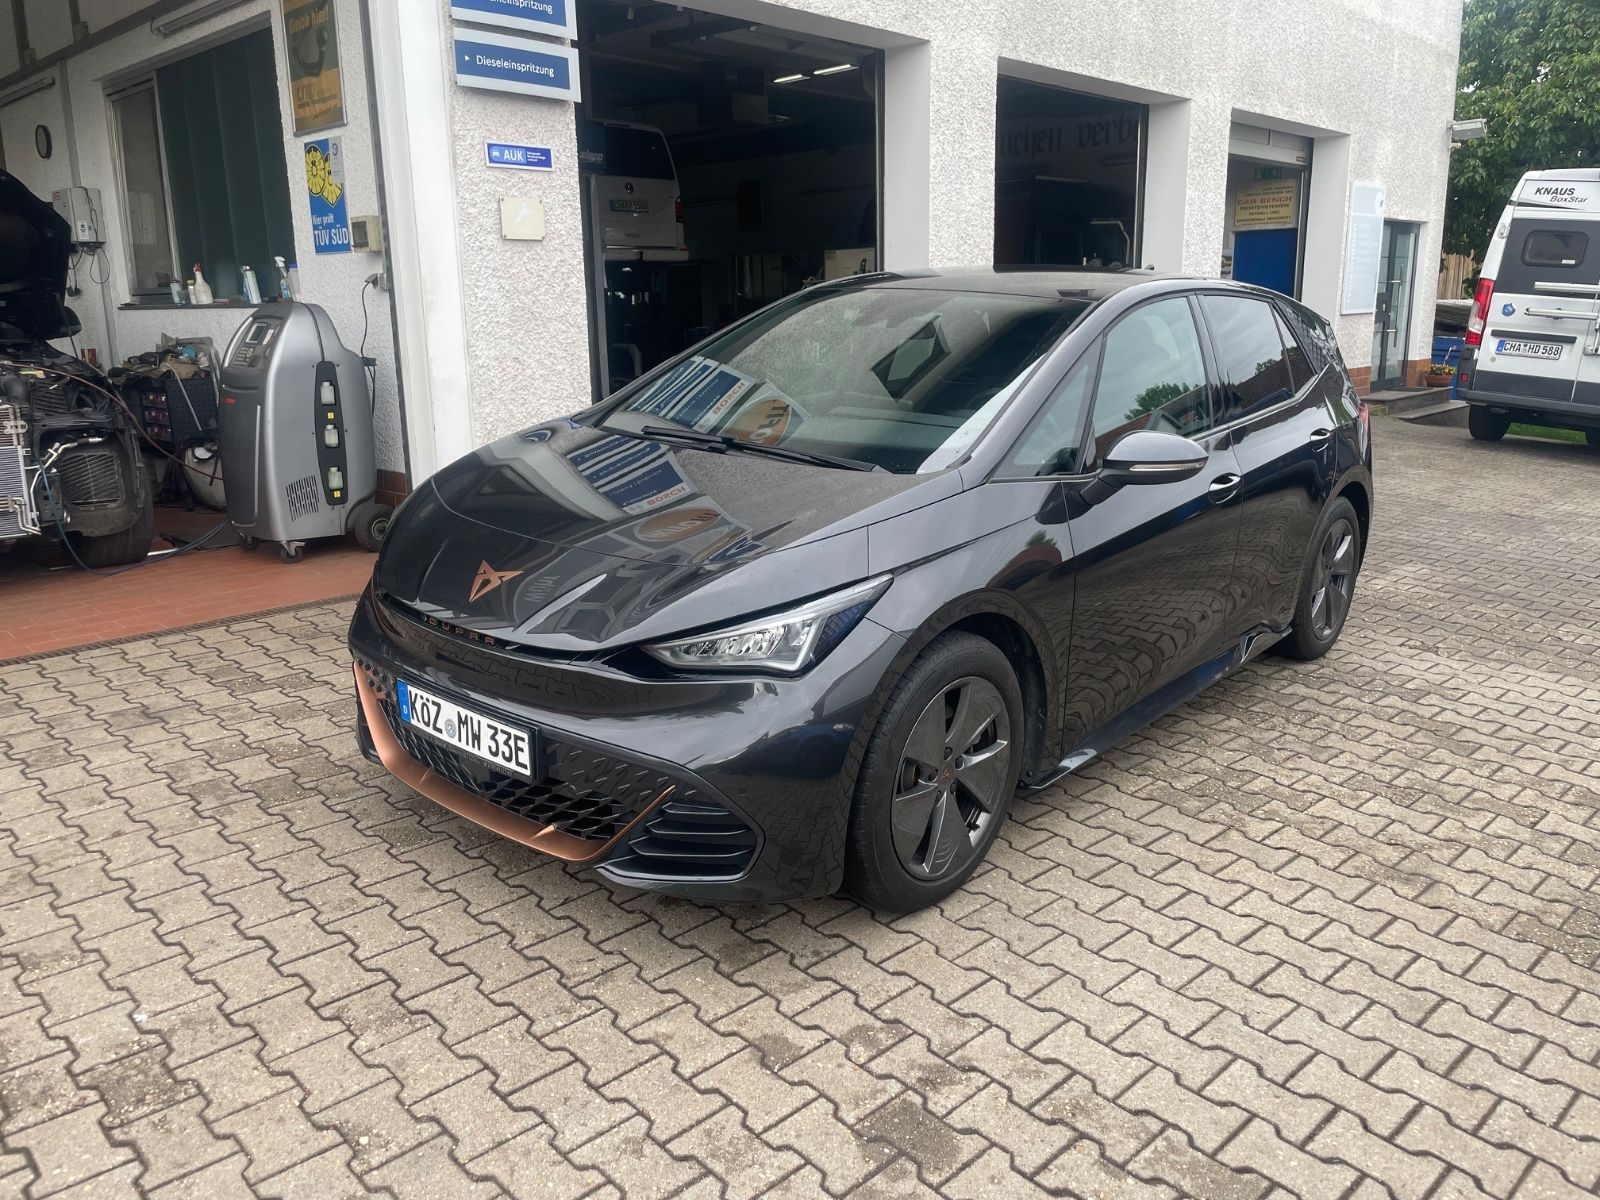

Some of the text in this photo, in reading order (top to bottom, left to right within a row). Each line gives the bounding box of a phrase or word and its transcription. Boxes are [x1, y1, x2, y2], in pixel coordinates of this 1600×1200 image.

[476, 55, 554, 77] Dieseleinspritzung
[504, 150, 524, 161] AUK
[1535, 187, 1576, 196] KNAUS
[1549, 195, 1589, 203] BoxStar
[314, 224, 349, 246] TÜV SÜD
[1504, 342, 1559, 356] CHA HD 588
[429, 617, 496, 646] CUPRA
[409, 690, 443, 735] KÖZ
[457, 711, 481, 752] MW
[487, 723, 529, 771] 33E
